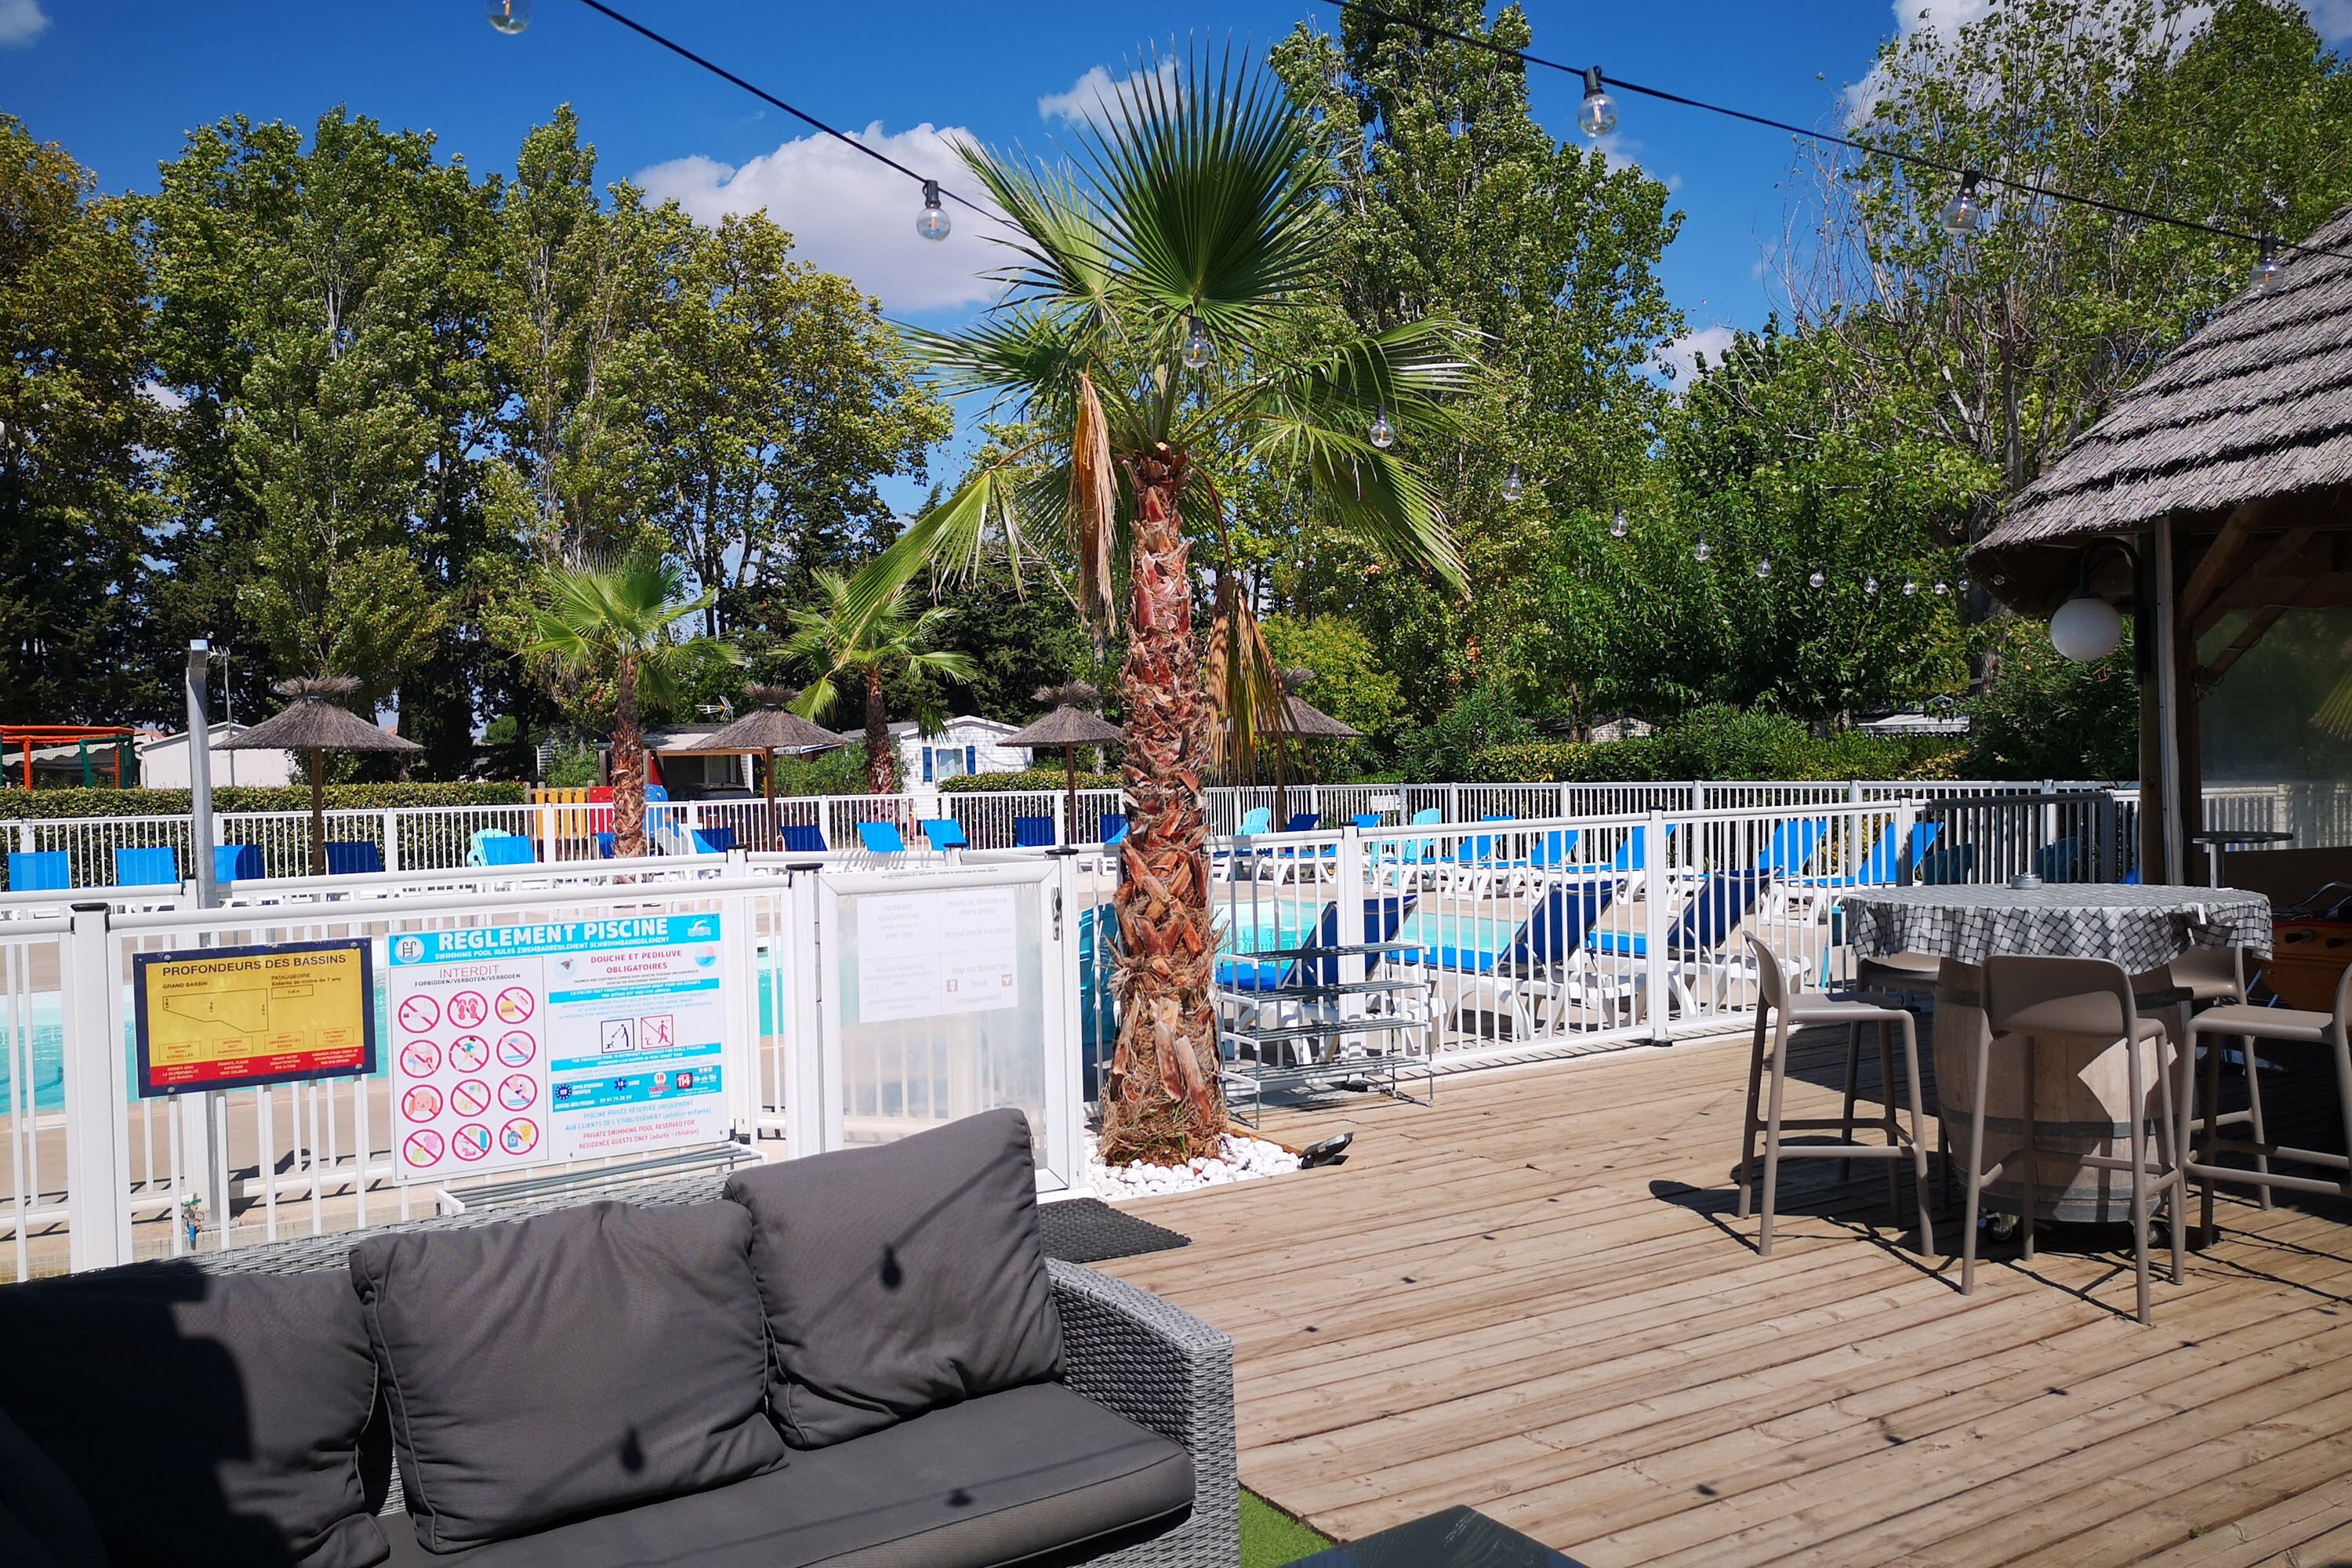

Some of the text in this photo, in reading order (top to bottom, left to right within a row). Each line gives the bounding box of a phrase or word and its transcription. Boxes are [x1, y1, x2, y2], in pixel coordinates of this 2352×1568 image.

[438, 917, 669, 951] REGLEMENT PISCINE
[434, 951, 472, 960] SWIMMING
[517, 942, 588, 953] ZWEMBADREGLEMENT
[590, 954, 626, 964] DOUCHE
[641, 949, 682, 959] PEDILUVE
[162, 954, 347, 977] PROFONDEURS DES BASSINS
[439, 964, 500, 978] INTERDIT
[606, 962, 668, 974] OBLIGATOIRES
[952, 966, 966, 975] slip
[978, 964, 999, 972] boxer
[414, 973, 521, 987] FORBIDDEN/VERBOTEN/VERBODEN
[971, 979, 989, 989] bain
[956, 993, 1002, 1005] uniquement
[677, 1075, 691, 1087] 114
[583, 1110, 606, 1119] PISCINE
[657, 1100, 692, 1110] UNIQUEMENT
[578, 1121, 602, 1130] CLIENTS
[583, 1131, 606, 1140] PRIVATE
[608, 1127, 637, 1137] SWIMMING
[655, 1121, 682, 1131] RESERVED
[579, 1140, 611, 1149] RESIDENCE
[612, 1137, 633, 1145] GUESTS
[650, 1132, 670, 1142] (adults
[674, 1127, 699, 1137] children)
